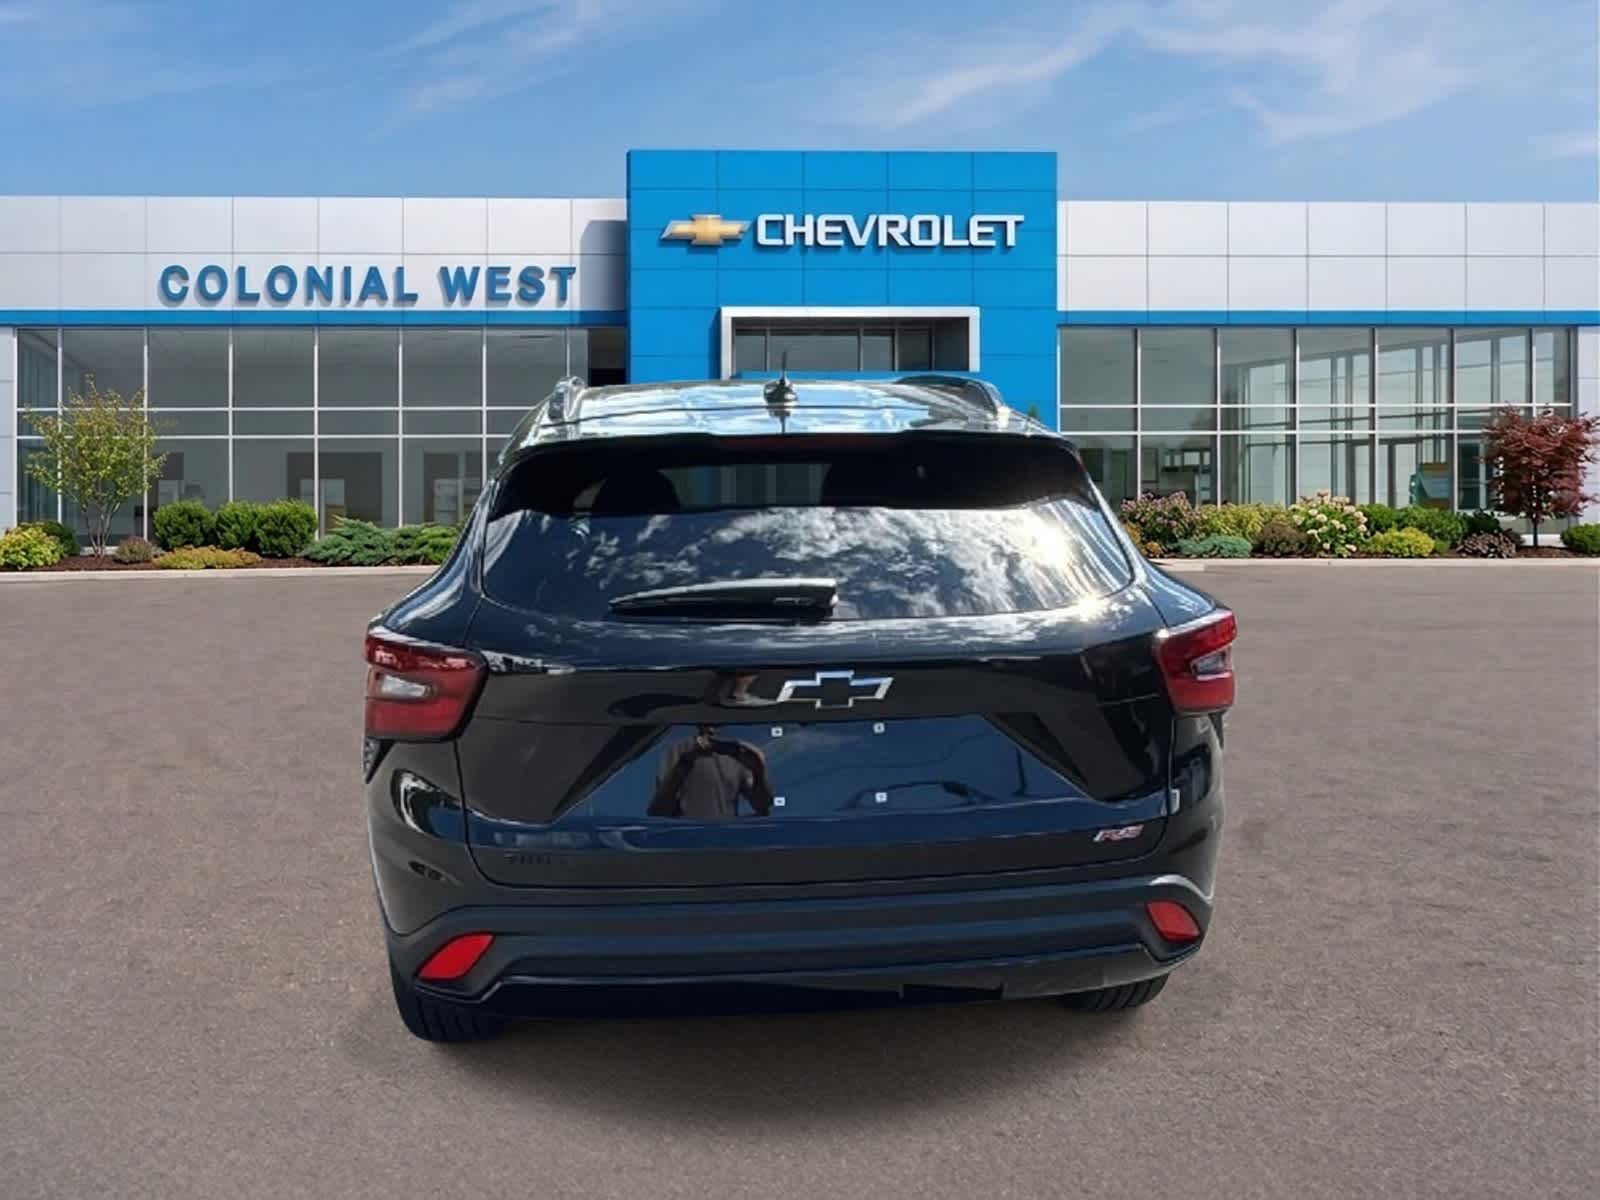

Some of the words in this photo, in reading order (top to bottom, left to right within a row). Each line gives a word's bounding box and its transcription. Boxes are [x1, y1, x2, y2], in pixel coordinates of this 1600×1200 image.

[756, 213, 1025, 248] CHEVROLET
[160, 264, 419, 304] COLONIAL
[437, 265, 577, 304] WEST
